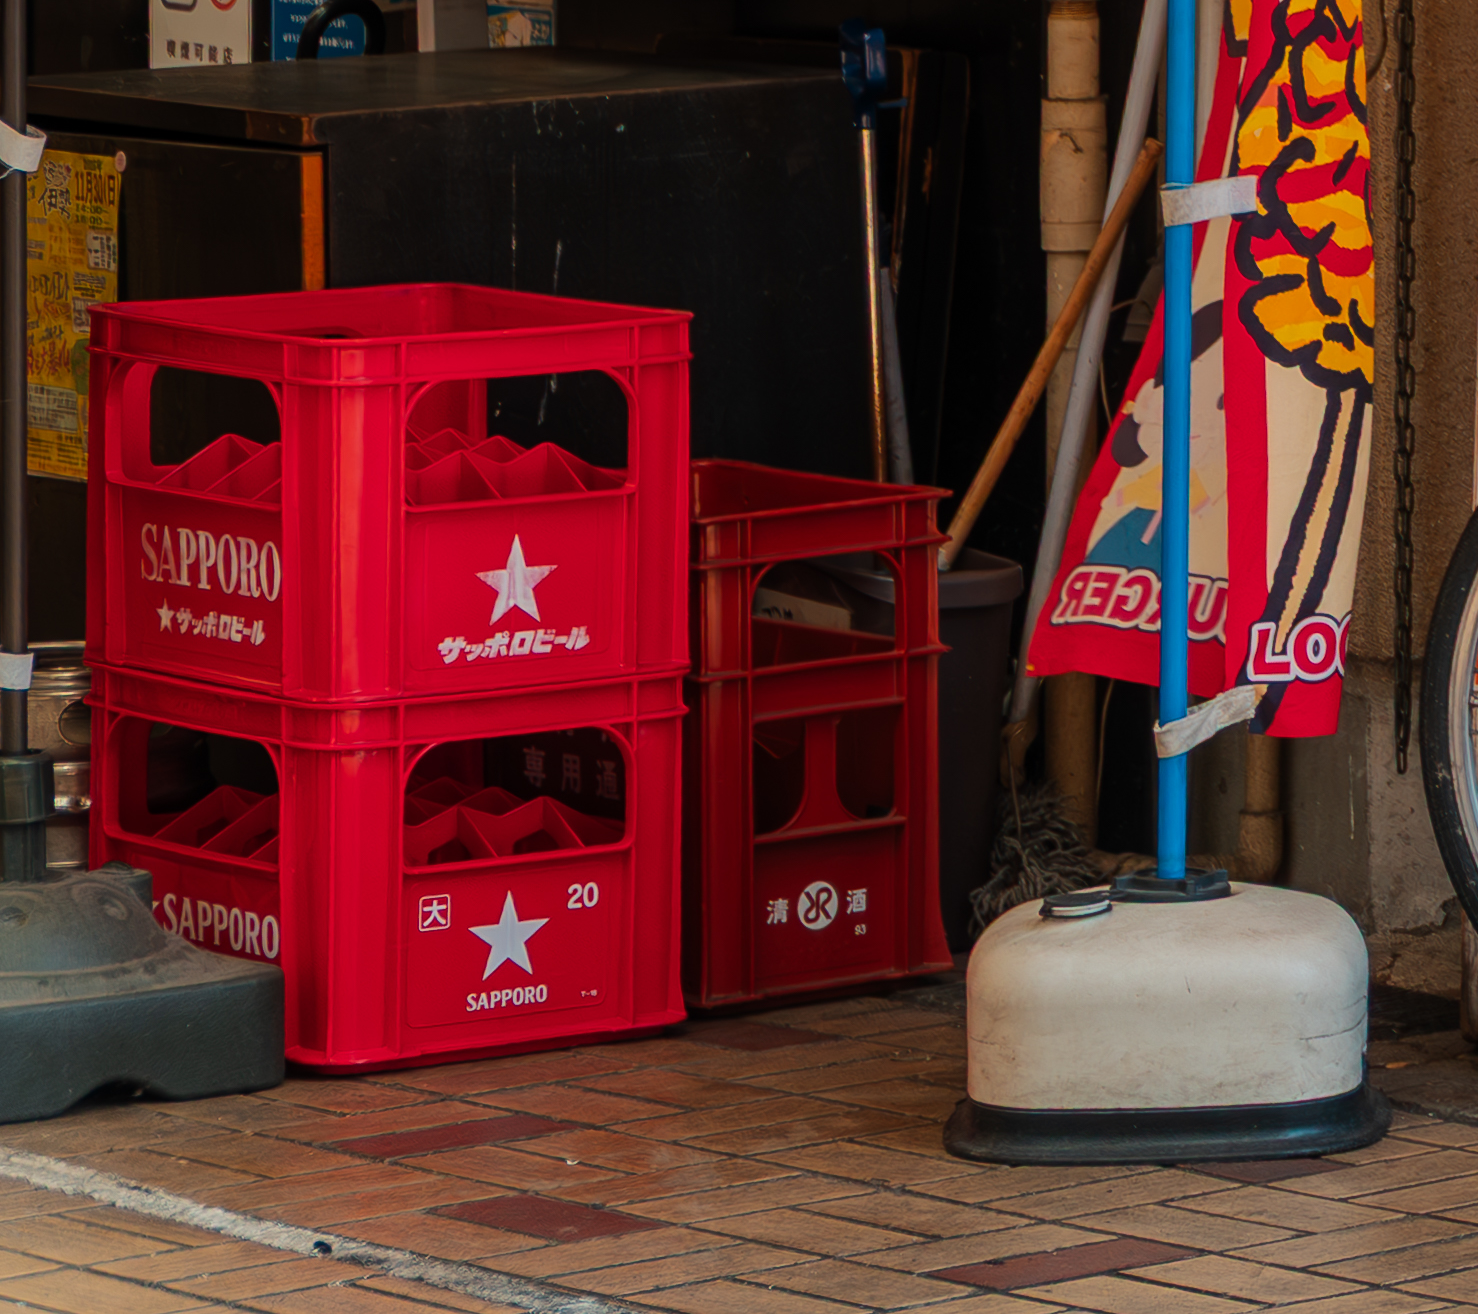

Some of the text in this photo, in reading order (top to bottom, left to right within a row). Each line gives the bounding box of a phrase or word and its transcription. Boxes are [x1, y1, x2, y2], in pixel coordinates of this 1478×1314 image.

[141, 522, 281, 602] SAPPORO
[176, 607, 591, 664] サッポロビール サッポロビール
[567, 882, 600, 910] 20
[846, 887, 868, 915] 酒
[163, 892, 280, 960] SAPPORO
[423, 899, 447, 927] 大
[466, 984, 548, 1012] SAPPORO
